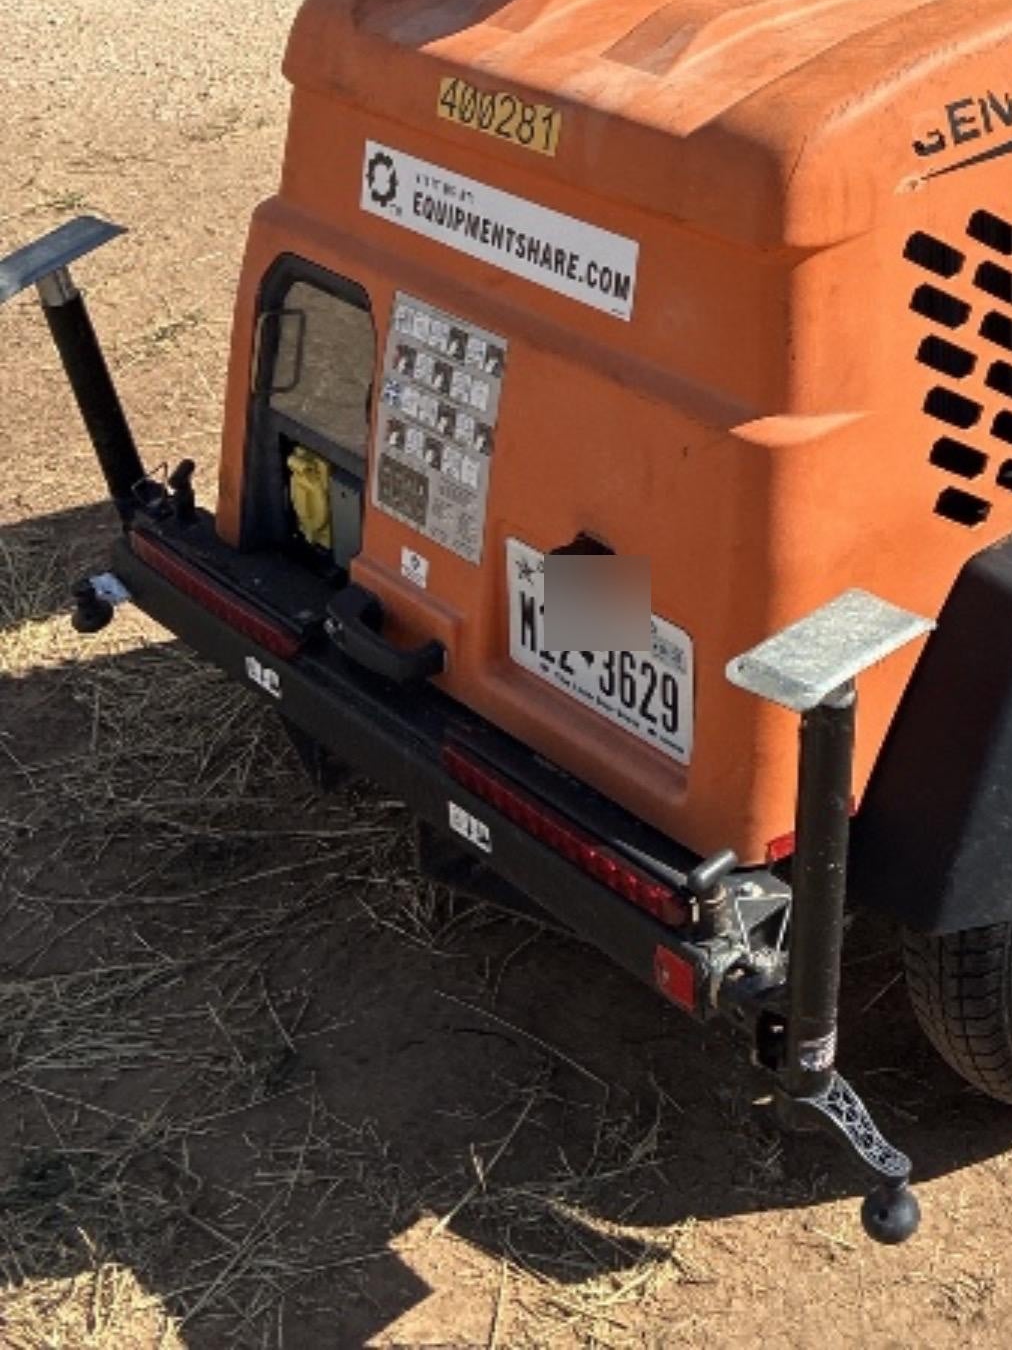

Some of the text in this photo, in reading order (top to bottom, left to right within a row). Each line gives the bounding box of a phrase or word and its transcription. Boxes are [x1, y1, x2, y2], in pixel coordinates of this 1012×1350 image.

[439, 80, 555, 151] 400281
[412, 191, 631, 301] EQUIPMENTSHARE.COM
[599, 650, 679, 735] 3629
